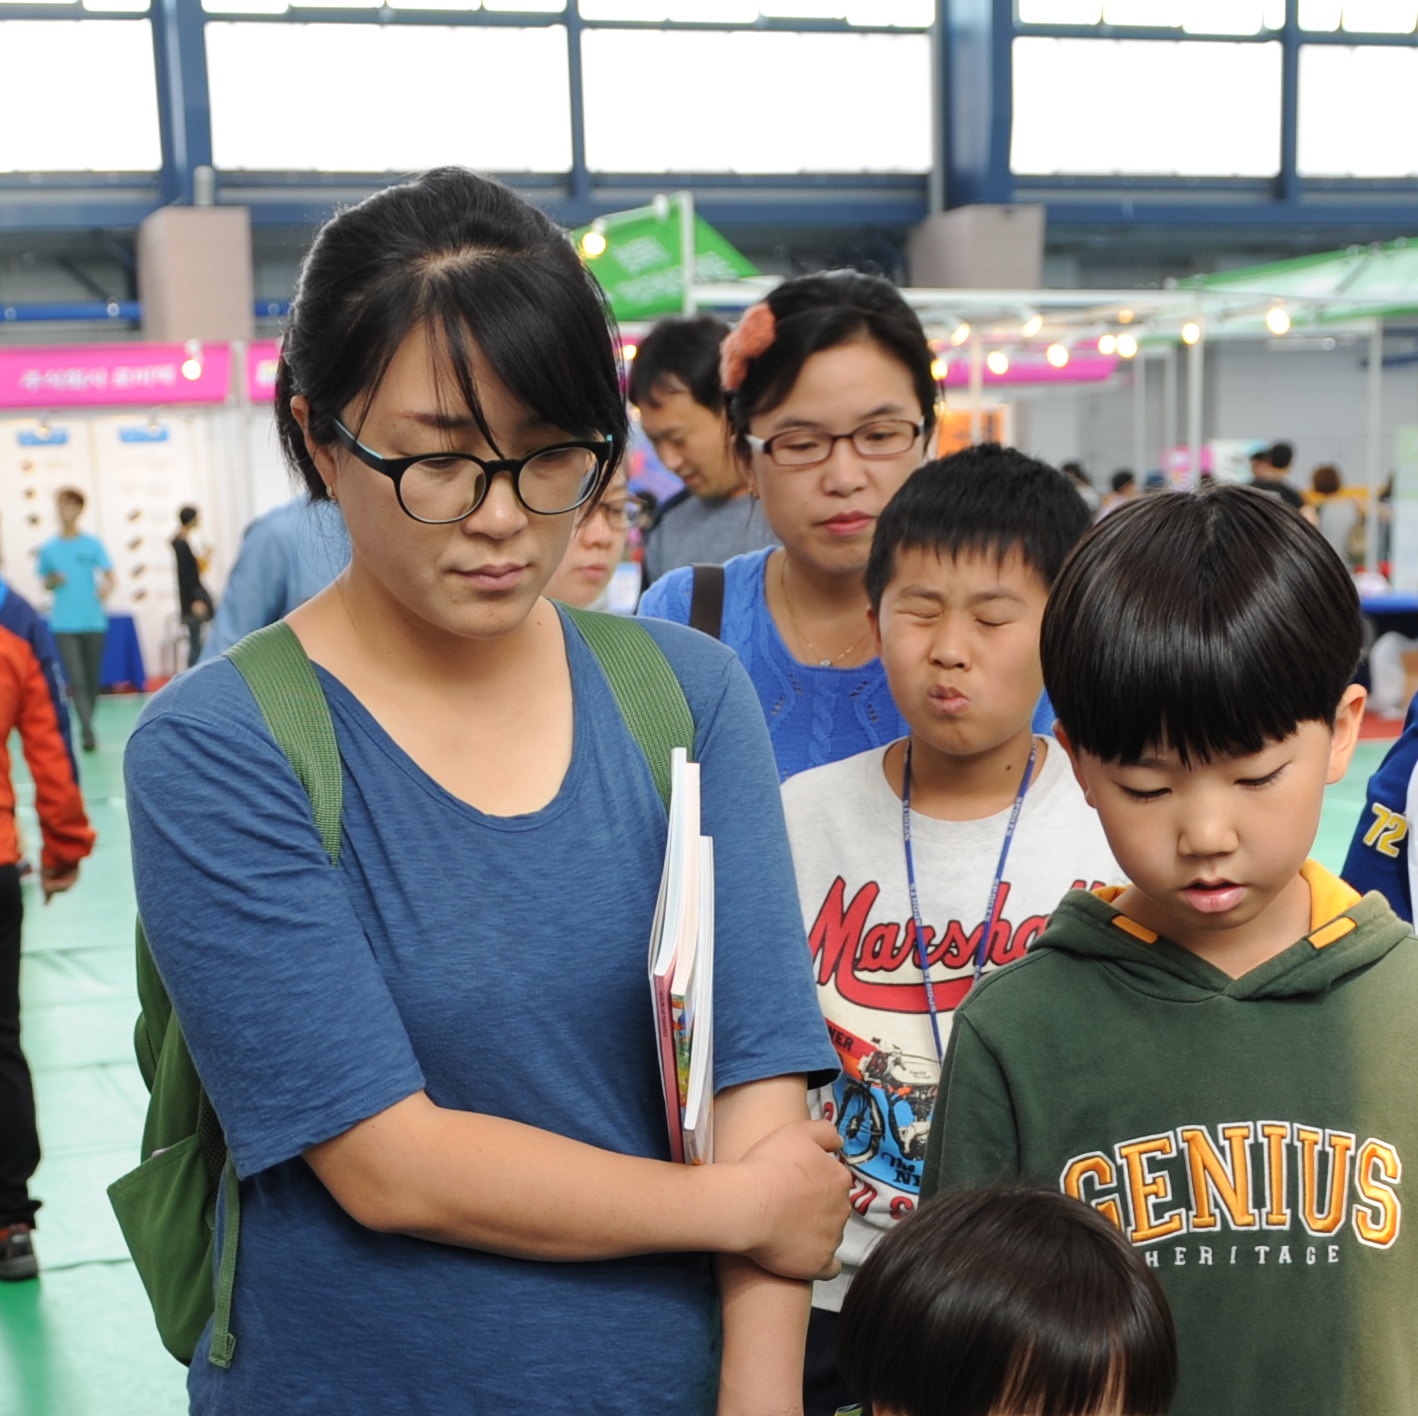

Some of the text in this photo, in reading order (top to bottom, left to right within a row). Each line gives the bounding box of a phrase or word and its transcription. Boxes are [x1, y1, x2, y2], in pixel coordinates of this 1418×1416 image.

[1363, 801, 1409, 859] 72
[807, 875, 1106, 995] Marsha
[1059, 1120, 1403, 1251] GENIUS
[1144, 1244, 1340, 1268] HERITAGE
